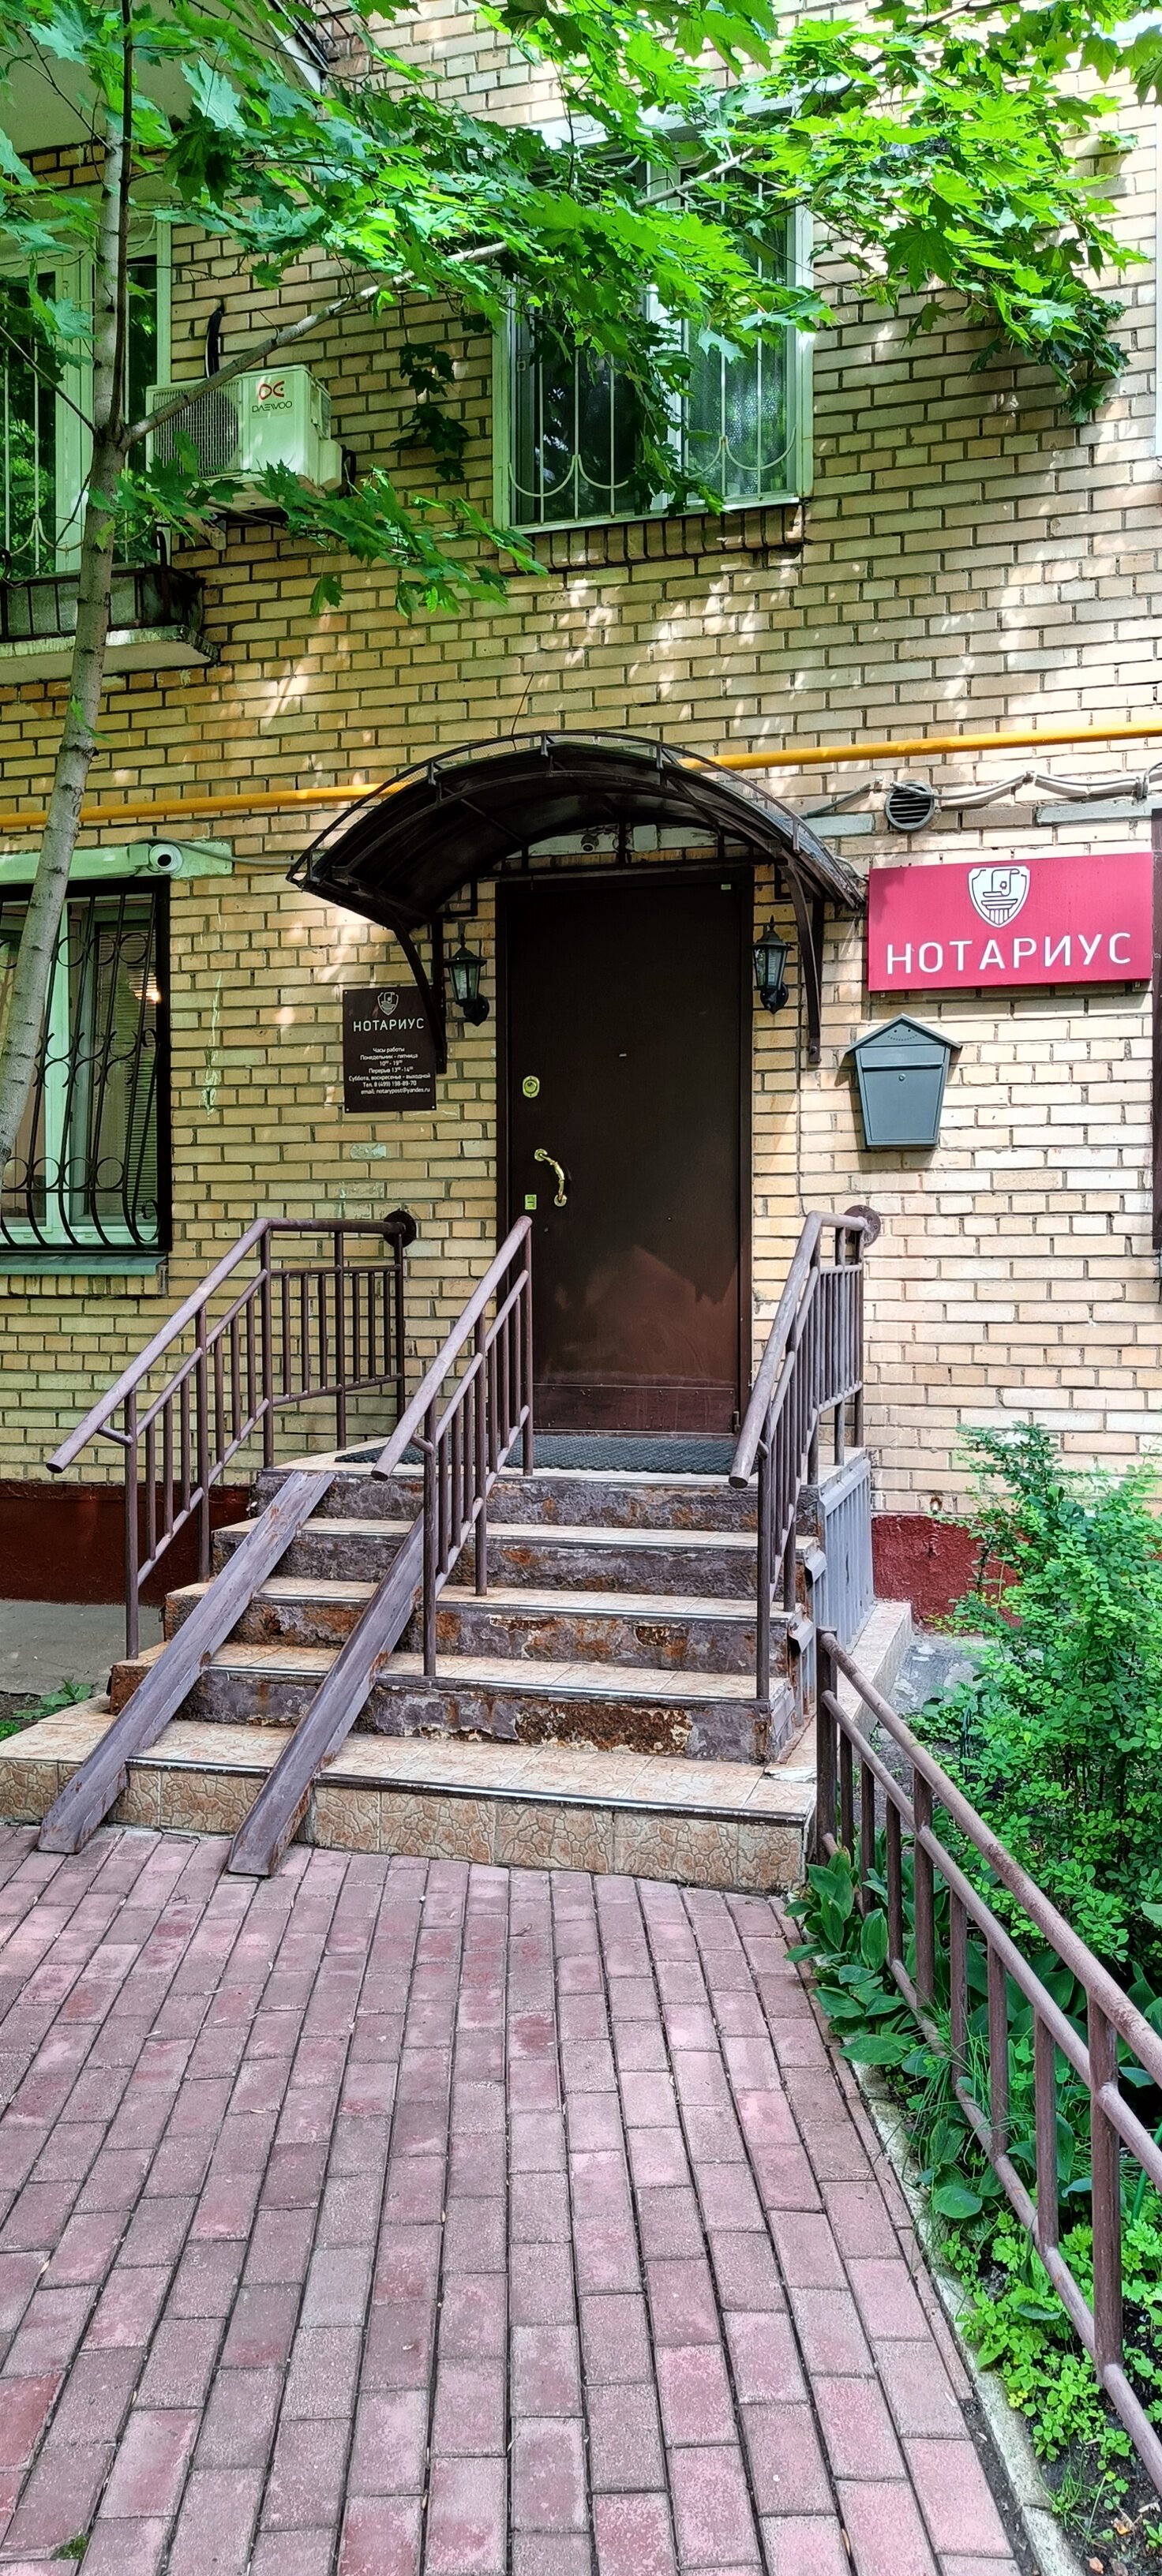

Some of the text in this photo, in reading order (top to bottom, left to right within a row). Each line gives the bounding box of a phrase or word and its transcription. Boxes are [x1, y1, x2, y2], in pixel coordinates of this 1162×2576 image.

[252, 400, 292, 412] DAEWOO
[886, 932, 1131, 975] НОТАРИУС
[353, 1018, 424, 1032] НОТАРИУС
